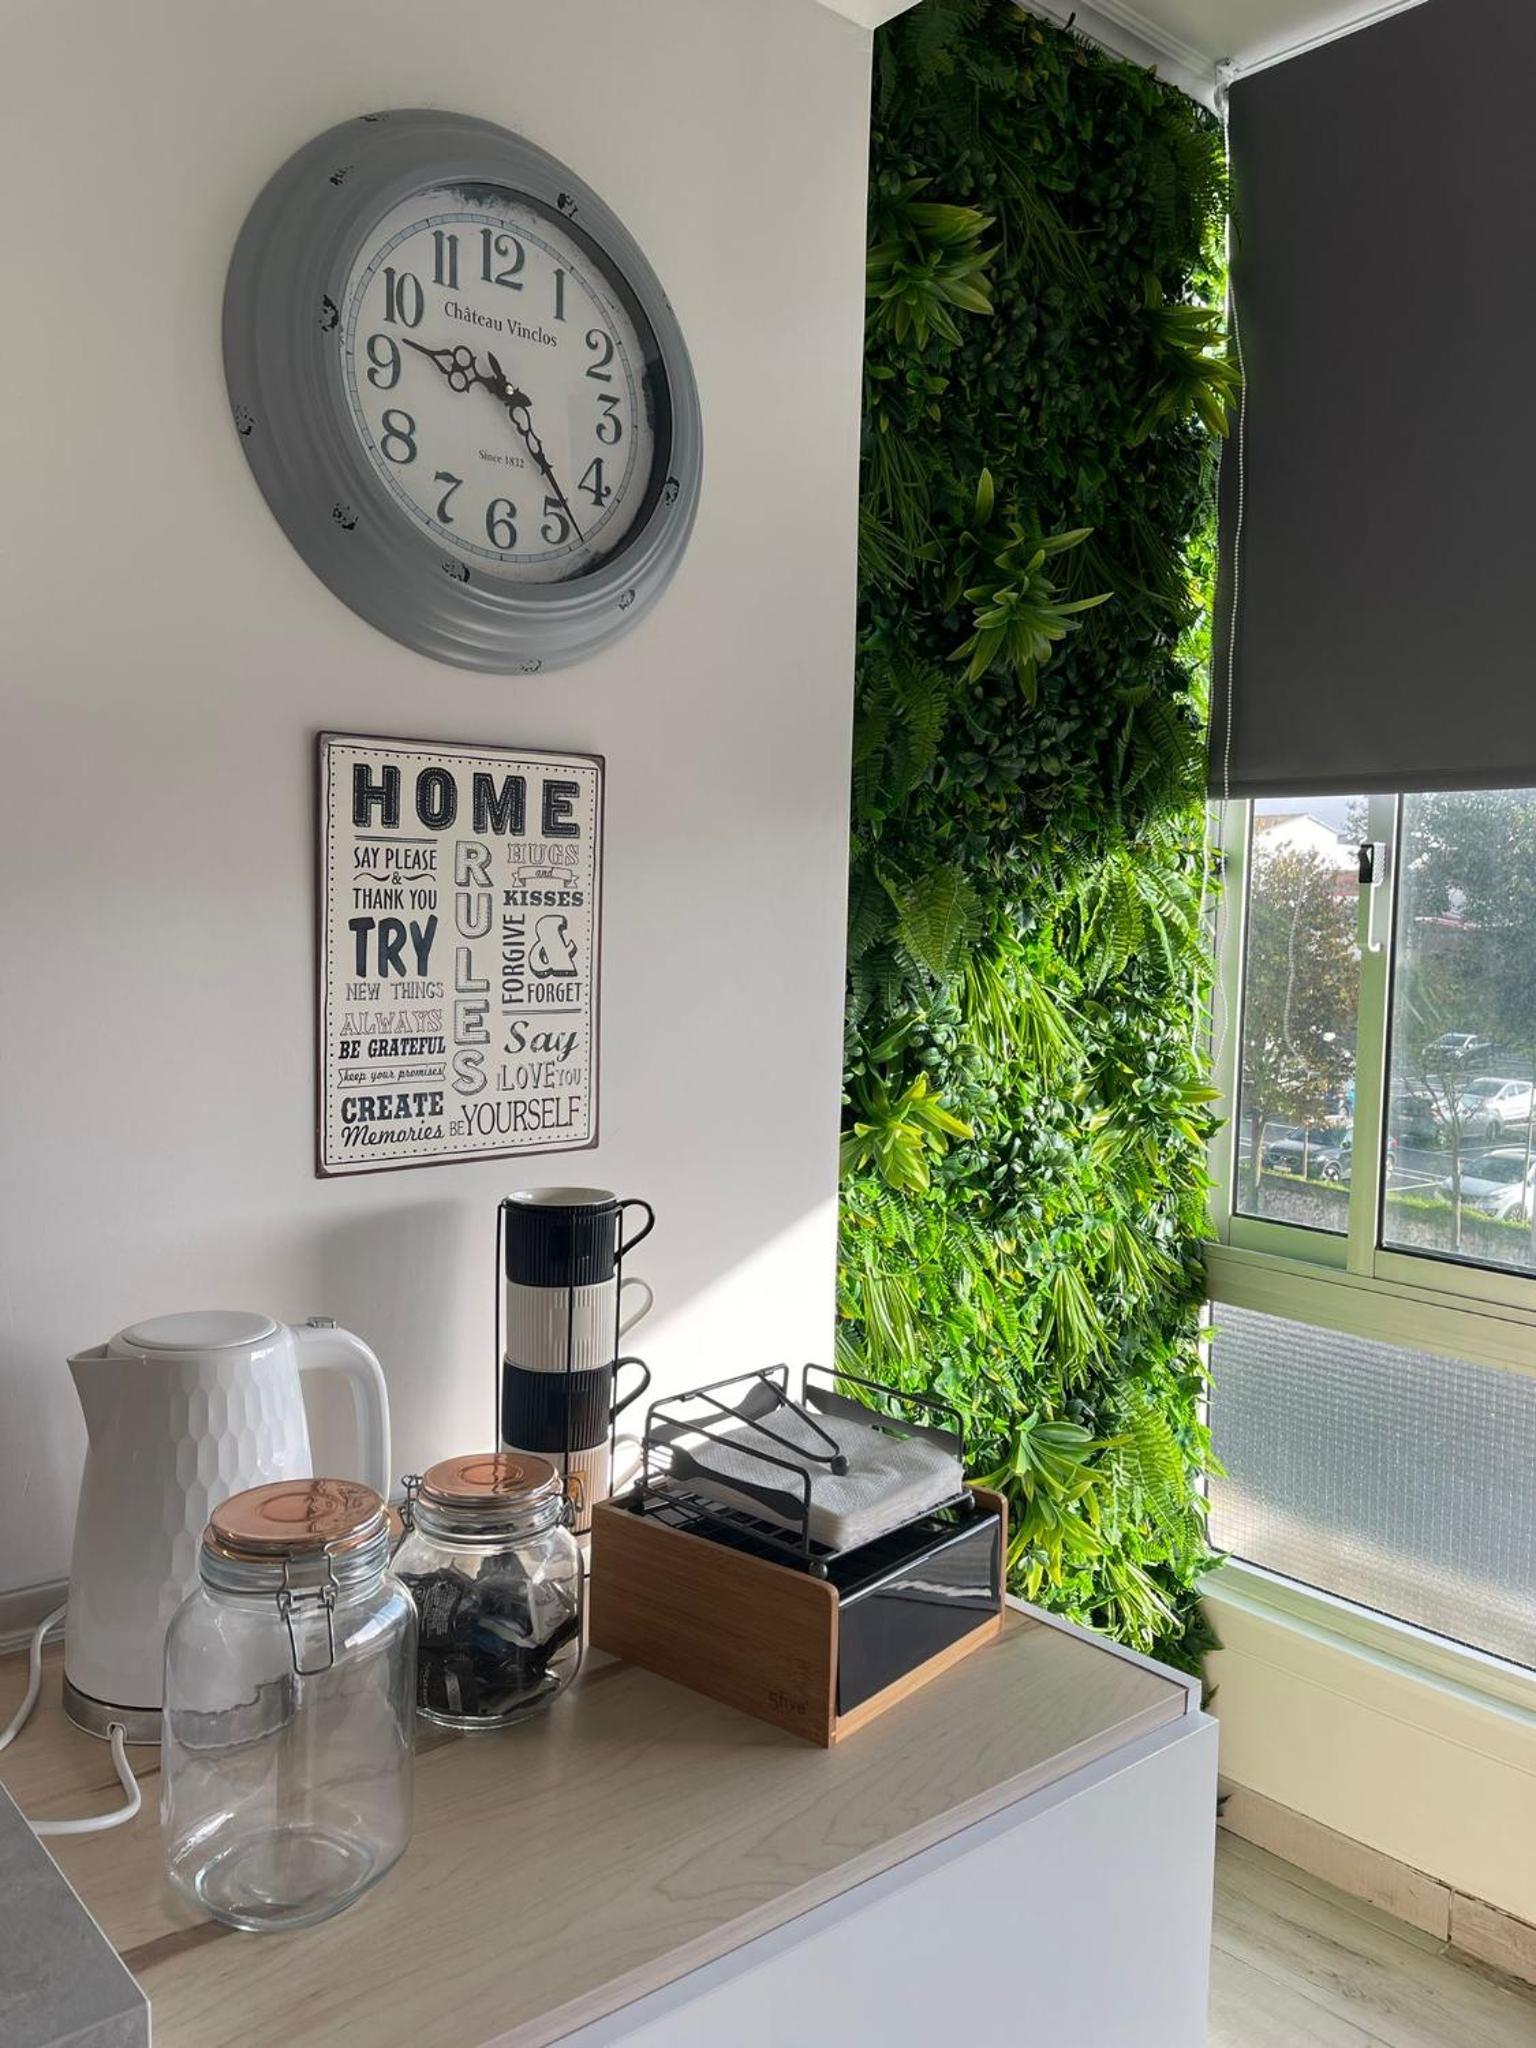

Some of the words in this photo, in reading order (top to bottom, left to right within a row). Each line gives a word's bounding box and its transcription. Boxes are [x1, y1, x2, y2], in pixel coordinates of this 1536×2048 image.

[432, 230, 459, 290] 11
[478, 227, 526, 291] 12
[382, 266, 424, 328] 10
[552, 267, 567, 321] 1
[444, 301, 502, 332] Château
[507, 319, 558, 347] Vinclos
[366, 333, 401, 389] 9
[585, 328, 614, 383] 2
[380, 408, 418, 465] 8
[595, 394, 622, 445] 3
[434, 471, 463, 524] 7
[577, 456, 612, 507] 4
[485, 498, 517, 549] 6
[540, 495, 571, 545] 5
[352, 763, 581, 839] HOME
[353, 846, 380, 869] SAY
[385, 847, 437, 871] PLEASE
[507, 843, 579, 866] HUGS
[352, 888, 404, 910] THANK
[409, 889, 437, 910] YOU
[391, 871, 402, 885] &
[503, 890, 584, 907] KISSES
[348, 914, 438, 978] TRY
[502, 914, 525, 1004] FORGIVE
[345, 982, 381, 1001] NEW
[390, 981, 445, 1000] THINGS
[527, 982, 583, 1004] FORGET
[340, 1009, 443, 1036] ALWAYS
[503, 1020, 579, 1062] Say
[338, 1040, 361, 1059] BE
[368, 1036, 446, 1058] GRATEFUL
[344, 1069, 366, 1083] keep
[370, 1070, 394, 1082] your
[398, 1066, 442, 1080] promises
[501, 1060, 555, 1092] LOVE
[556, 1068, 581, 1086] YOU
[341, 1091, 444, 1124] CREATE
[449, 1120, 465, 1137] BE
[461, 1095, 581, 1136] YOURSELF
[341, 1119, 445, 1147] Memories
